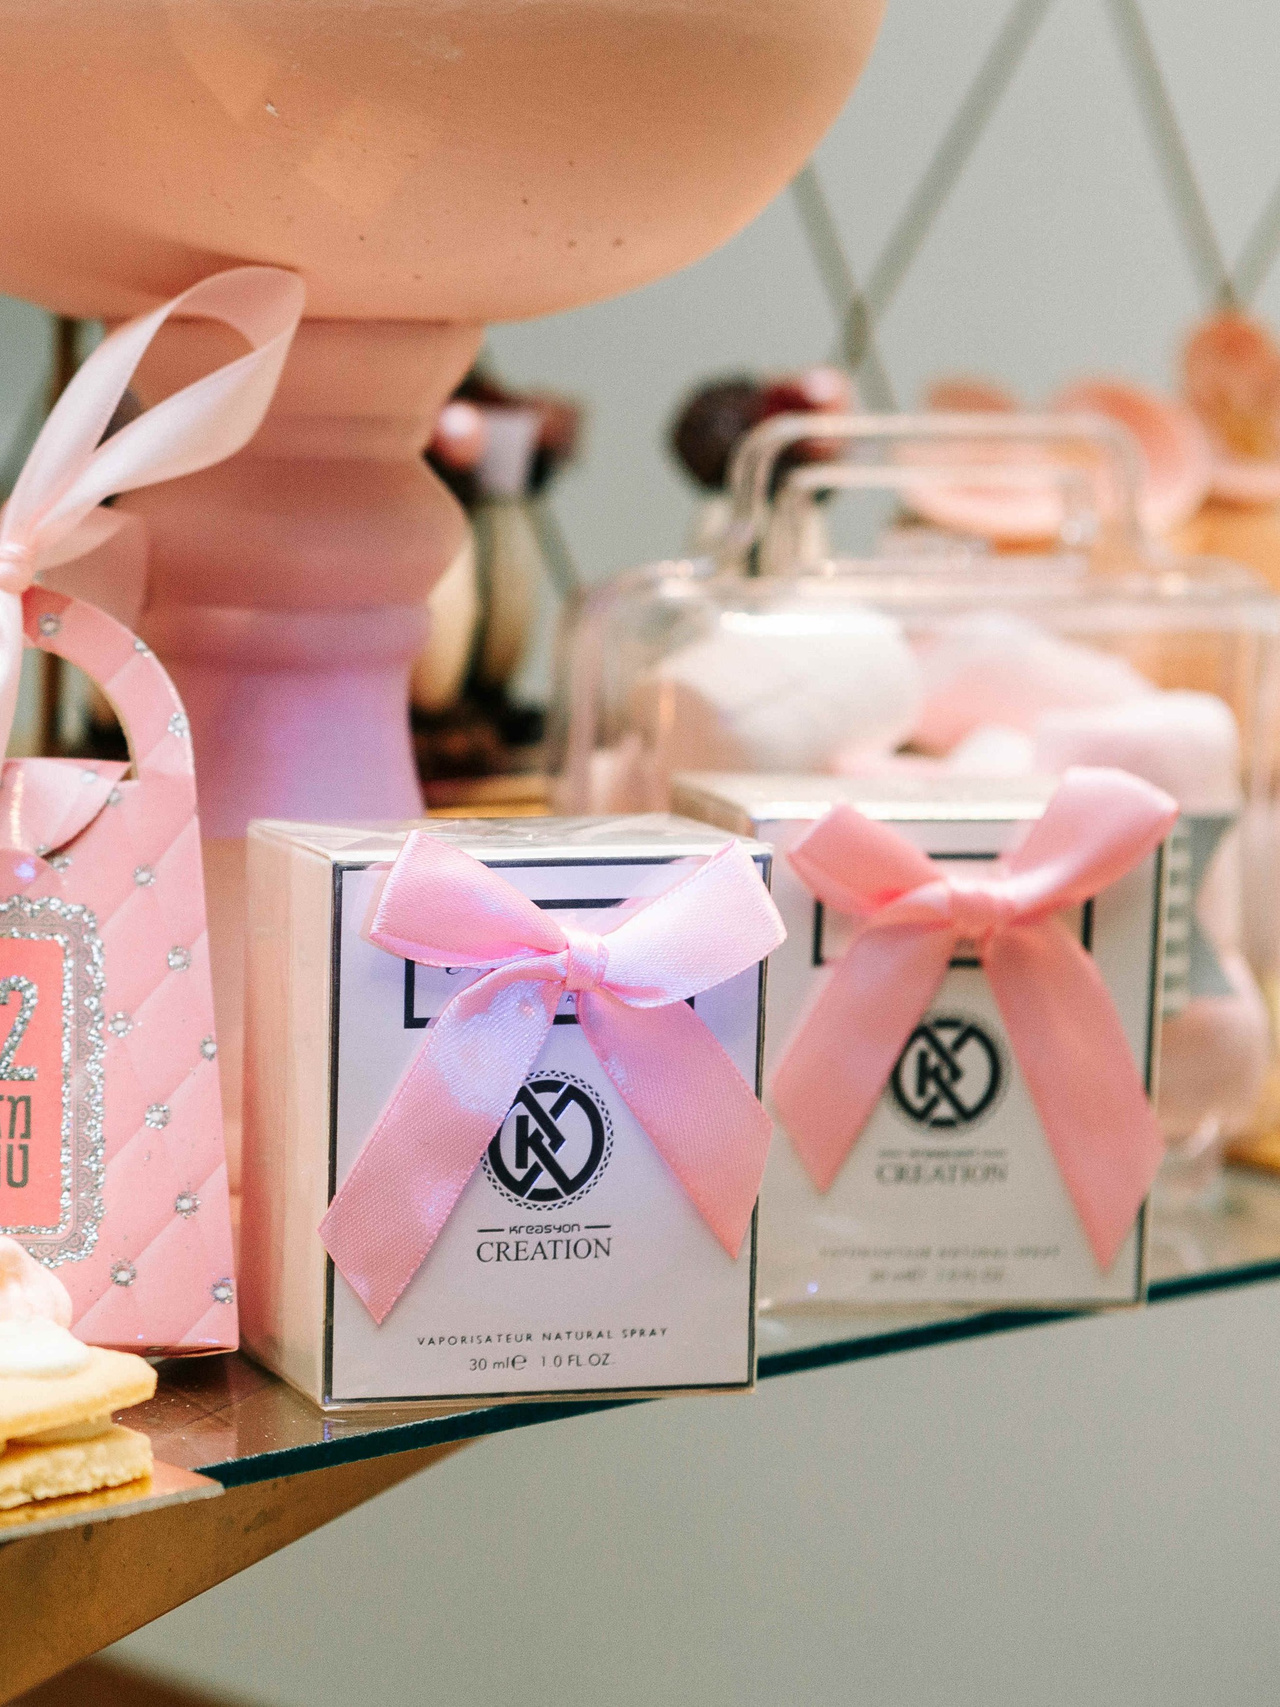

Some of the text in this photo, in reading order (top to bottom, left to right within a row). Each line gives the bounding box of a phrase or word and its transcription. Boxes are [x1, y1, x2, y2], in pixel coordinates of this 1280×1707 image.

[476, 1237, 612, 1263] CREATION
[417, 1327, 668, 1346] VAPORISATEUR NATURAL SPRAY
[469, 1358, 487, 1371] 30
